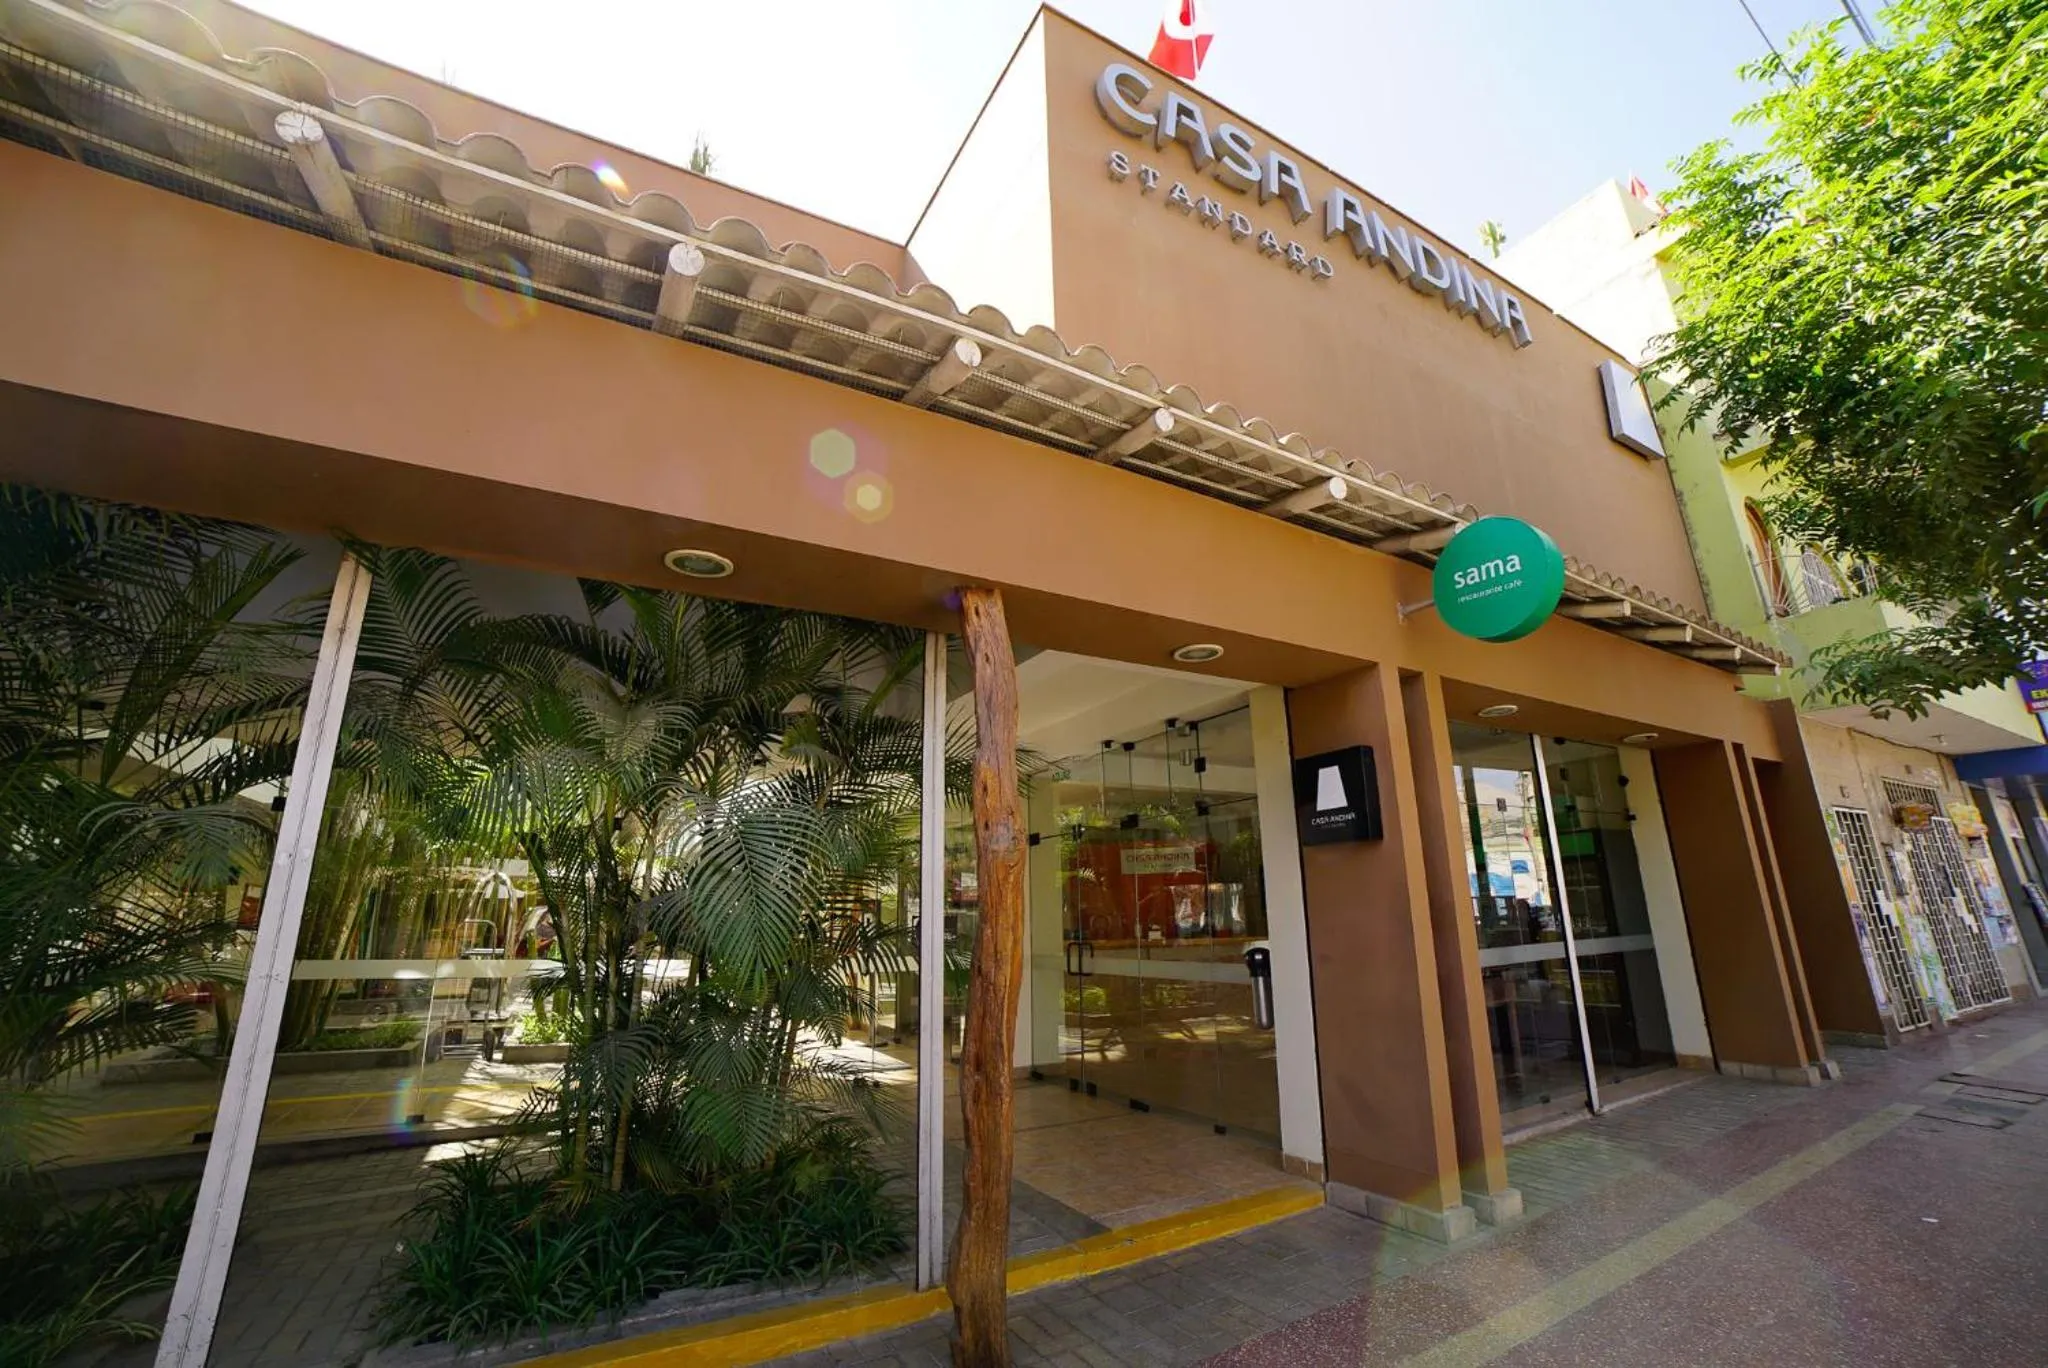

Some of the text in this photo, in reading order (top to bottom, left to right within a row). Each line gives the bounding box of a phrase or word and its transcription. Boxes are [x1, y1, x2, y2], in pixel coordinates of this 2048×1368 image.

[1097, 63, 1532, 350] CASA ANDINA
[1107, 150, 1334, 281] STANDARD
[1453, 554, 1522, 589] sama
